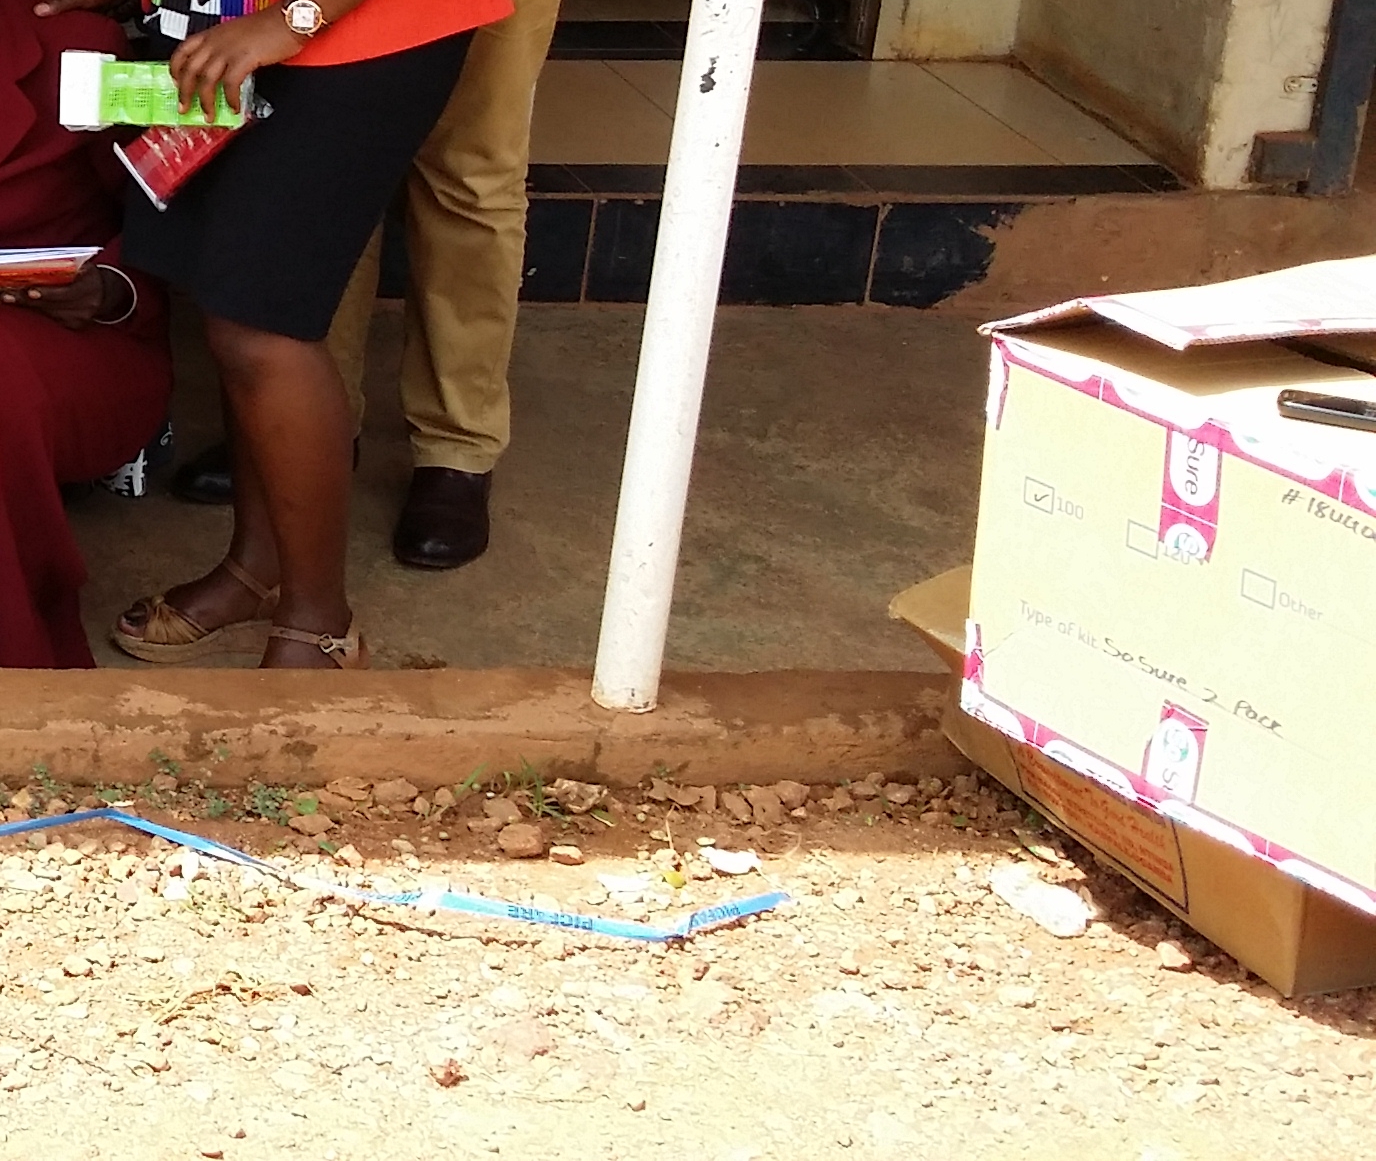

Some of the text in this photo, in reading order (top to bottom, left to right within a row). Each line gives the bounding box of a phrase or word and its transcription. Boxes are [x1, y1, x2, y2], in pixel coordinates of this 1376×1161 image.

[1056, 496, 1084, 520] 100
[1279, 591, 1323, 622] Other
[1020, 599, 1099, 649] Type of kit
